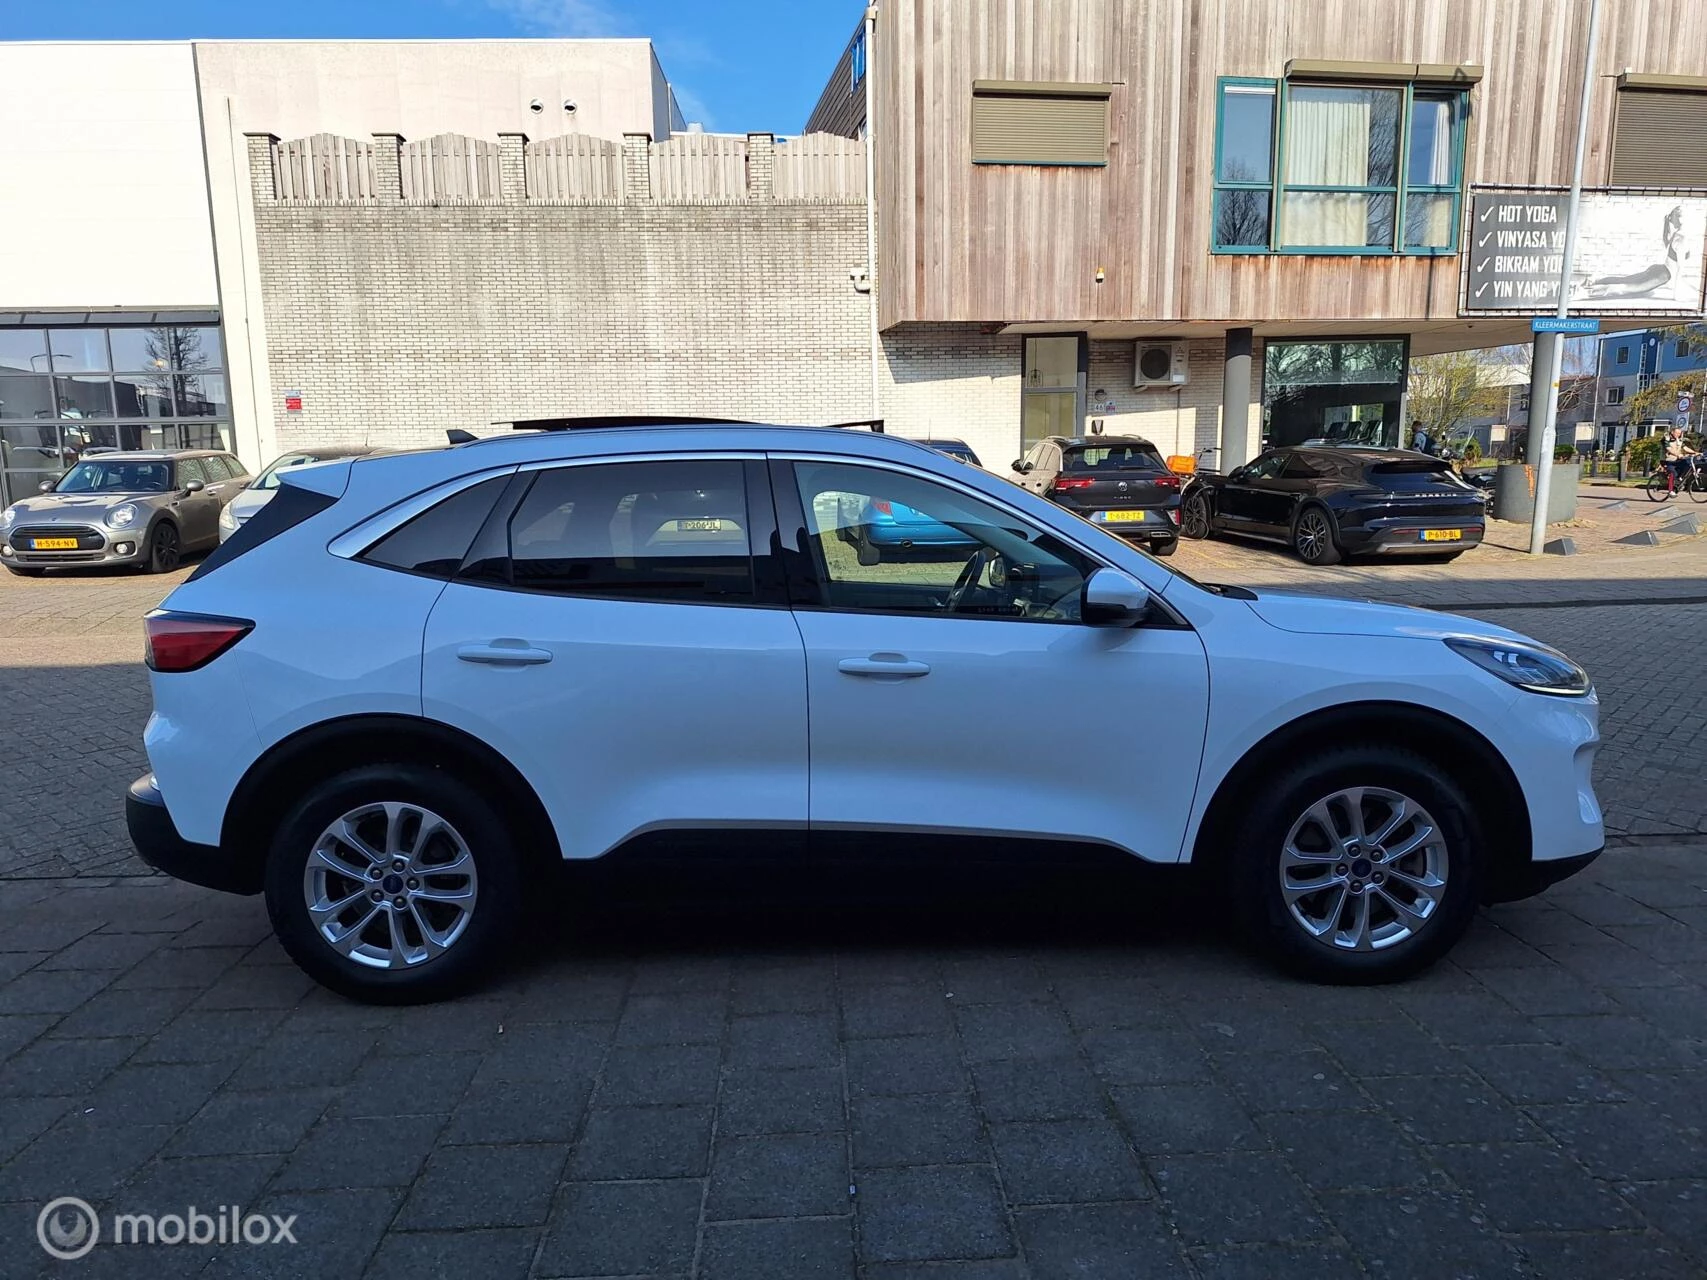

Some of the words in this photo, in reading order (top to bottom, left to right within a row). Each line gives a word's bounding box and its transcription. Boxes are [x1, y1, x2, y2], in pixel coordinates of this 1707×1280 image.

[1498, 205, 1523, 223] HOT
[1526, 205, 1557, 223] YOGA
[1497, 230, 1547, 248] VINYASA
[1551, 231, 1567, 249] YO
[1494, 255, 1540, 273] BIKRAM
[1493, 280, 1514, 298] YIN
[1516, 280, 1548, 298] YANG
[1535, 320, 1597, 330] KLEERMAKERSTRAAT
[36, 540, 75, 549] H-594-NV
